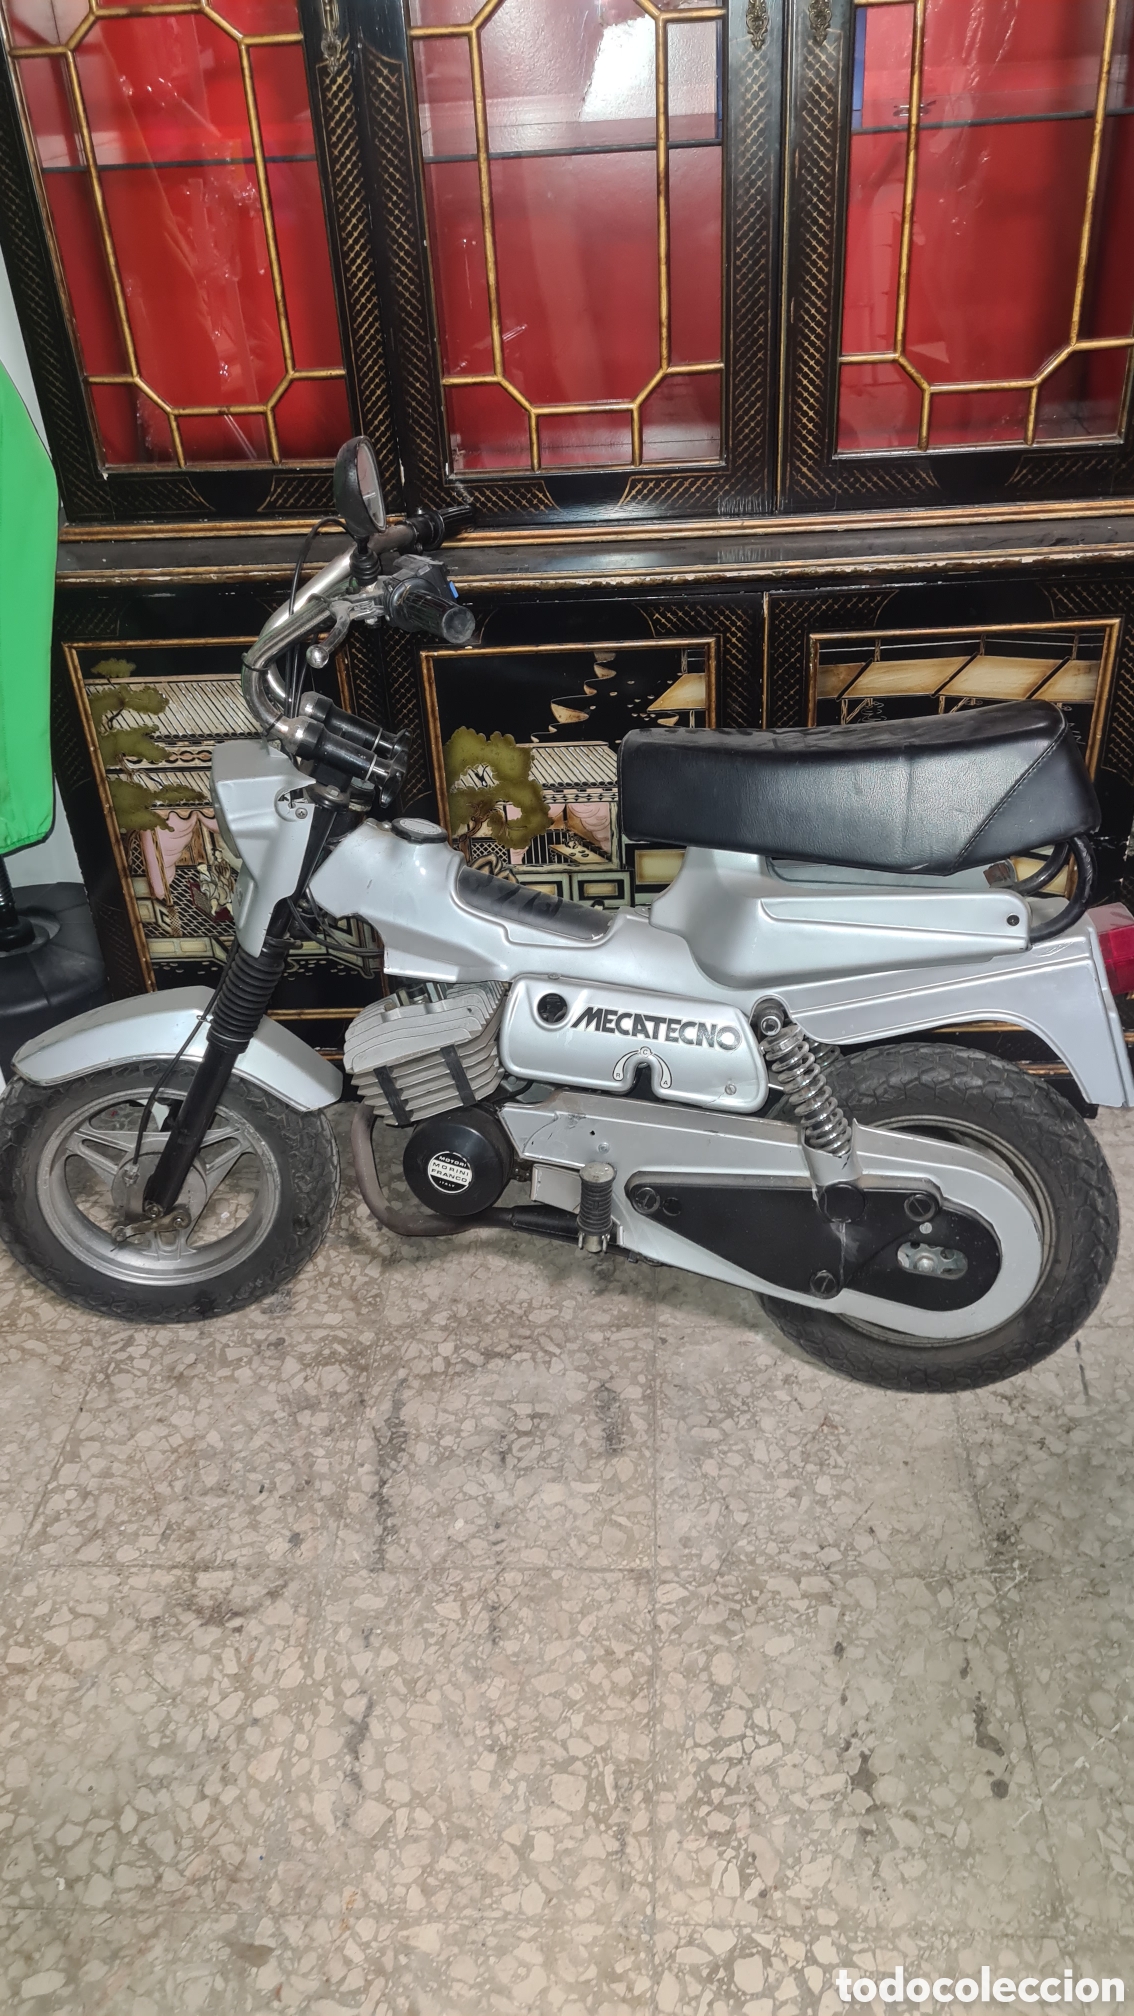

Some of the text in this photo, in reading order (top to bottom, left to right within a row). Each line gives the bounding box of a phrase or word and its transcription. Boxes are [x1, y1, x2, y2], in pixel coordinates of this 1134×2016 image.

[570, 1006, 742, 1051] MECATECNO
[439, 1155, 467, 1167] MOTORI
[431, 1168, 467, 1183] FRANCO
[432, 1162, 469, 1176] MORINI
[439, 1180, 455, 1188] ITALY
